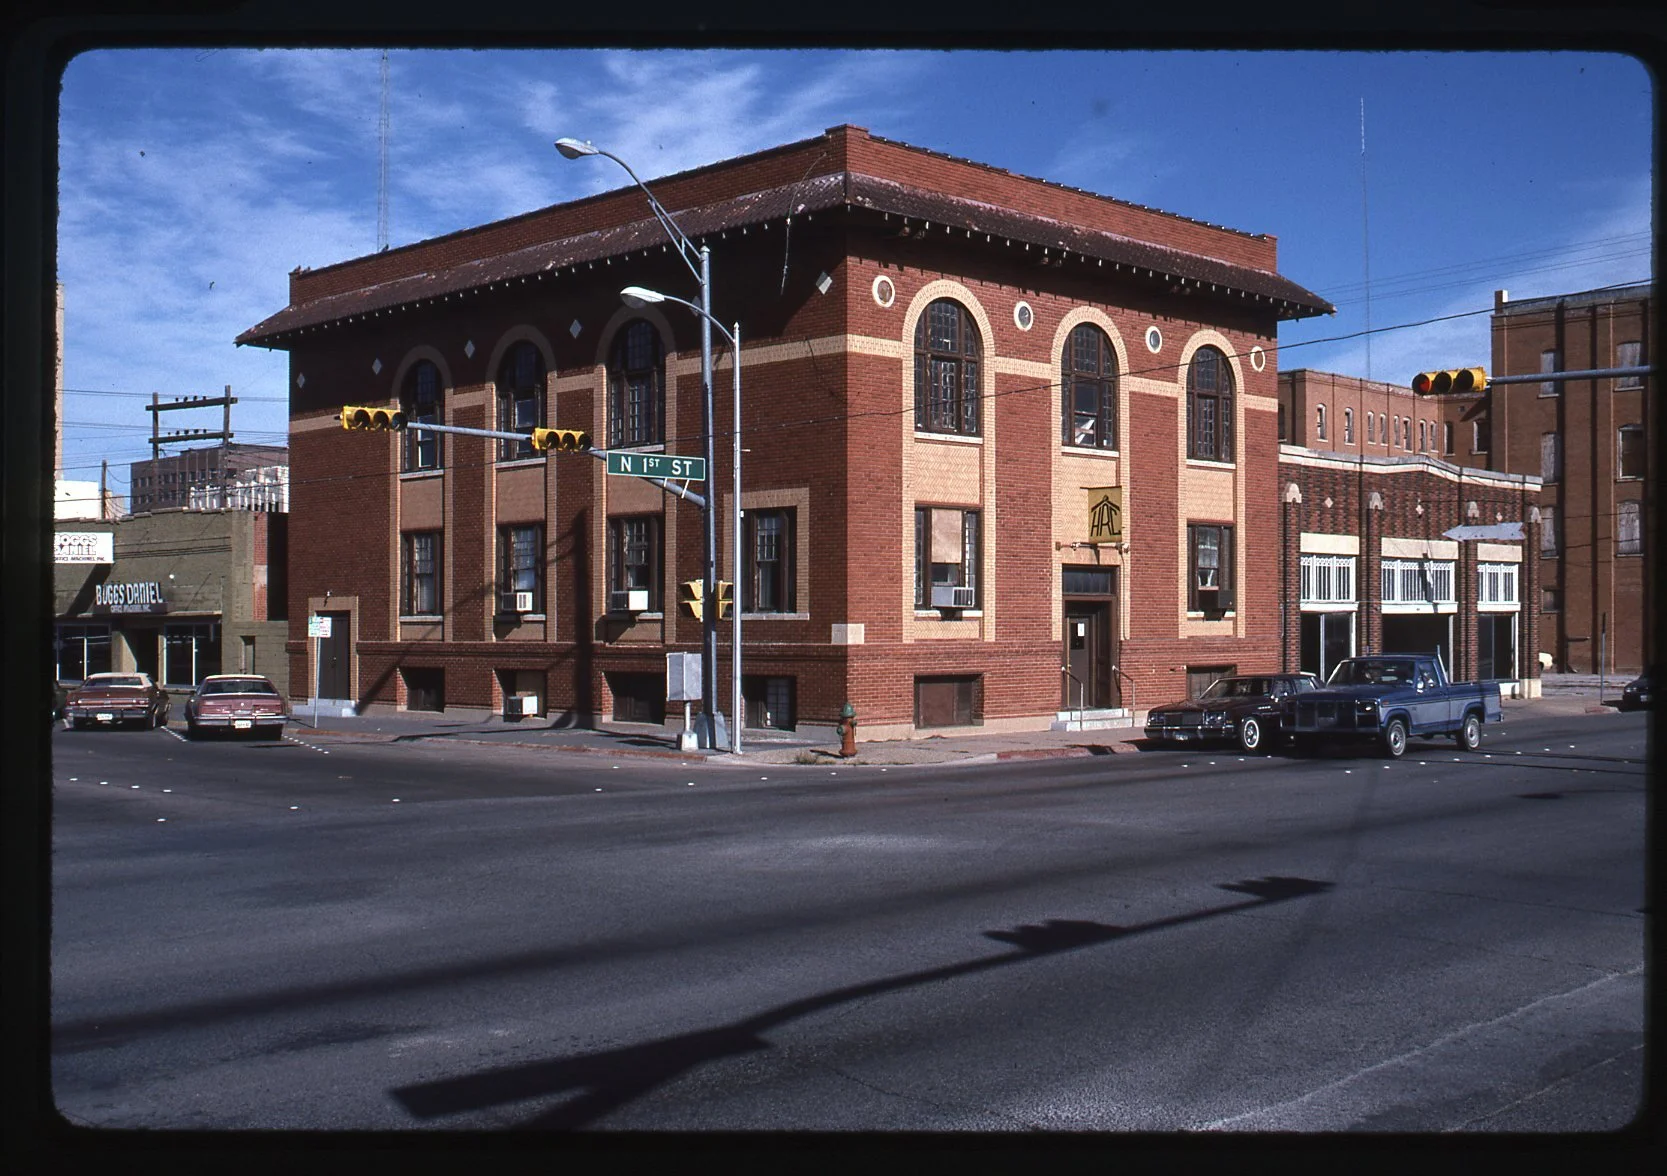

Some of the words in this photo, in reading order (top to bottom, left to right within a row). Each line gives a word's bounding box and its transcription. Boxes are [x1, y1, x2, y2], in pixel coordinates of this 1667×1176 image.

[620, 455, 632, 472] N
[642, 457, 660, 473] 1ST
[671, 459, 693, 476] ST
[126, 581, 164, 604] DANIEL
